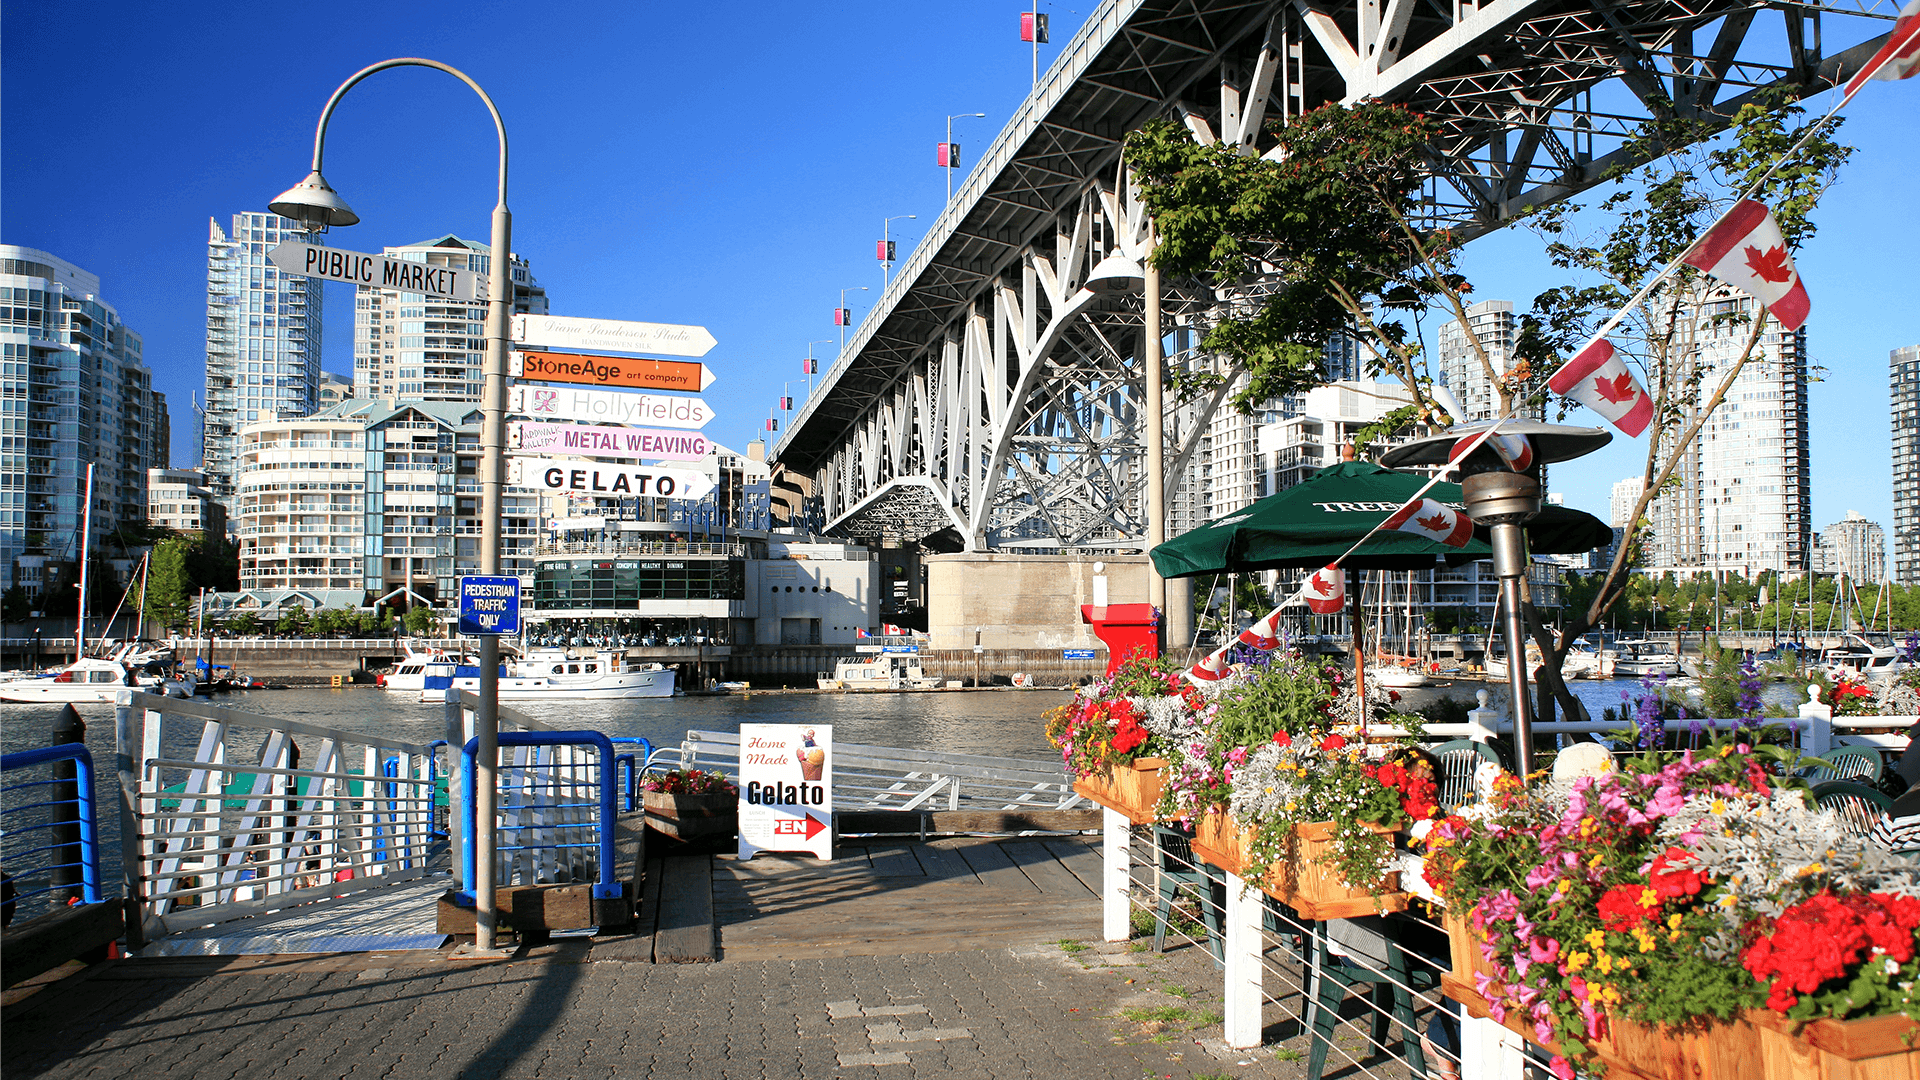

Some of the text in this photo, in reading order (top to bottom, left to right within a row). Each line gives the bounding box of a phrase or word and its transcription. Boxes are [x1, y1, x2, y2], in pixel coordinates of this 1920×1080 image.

[305, 247, 457, 295] PUBLIC MARKET
[544, 320, 691, 341] Diana Sanderson Studio
[581, 338, 652, 350] HANDWOVEN SILK
[525, 355, 688, 384] StoneAge art company
[573, 391, 703, 422] Hollyfields
[564, 430, 705, 455] METAL WEAVING
[544, 467, 676, 496] GELATO
[465, 584, 515, 597] PEDESTRIAN
[472, 598, 507, 611] TRAFFIC
[478, 613, 501, 626] ONLY
[747, 737, 786, 749] Home
[746, 753, 788, 766] Made
[747, 780, 824, 805] Gelato
